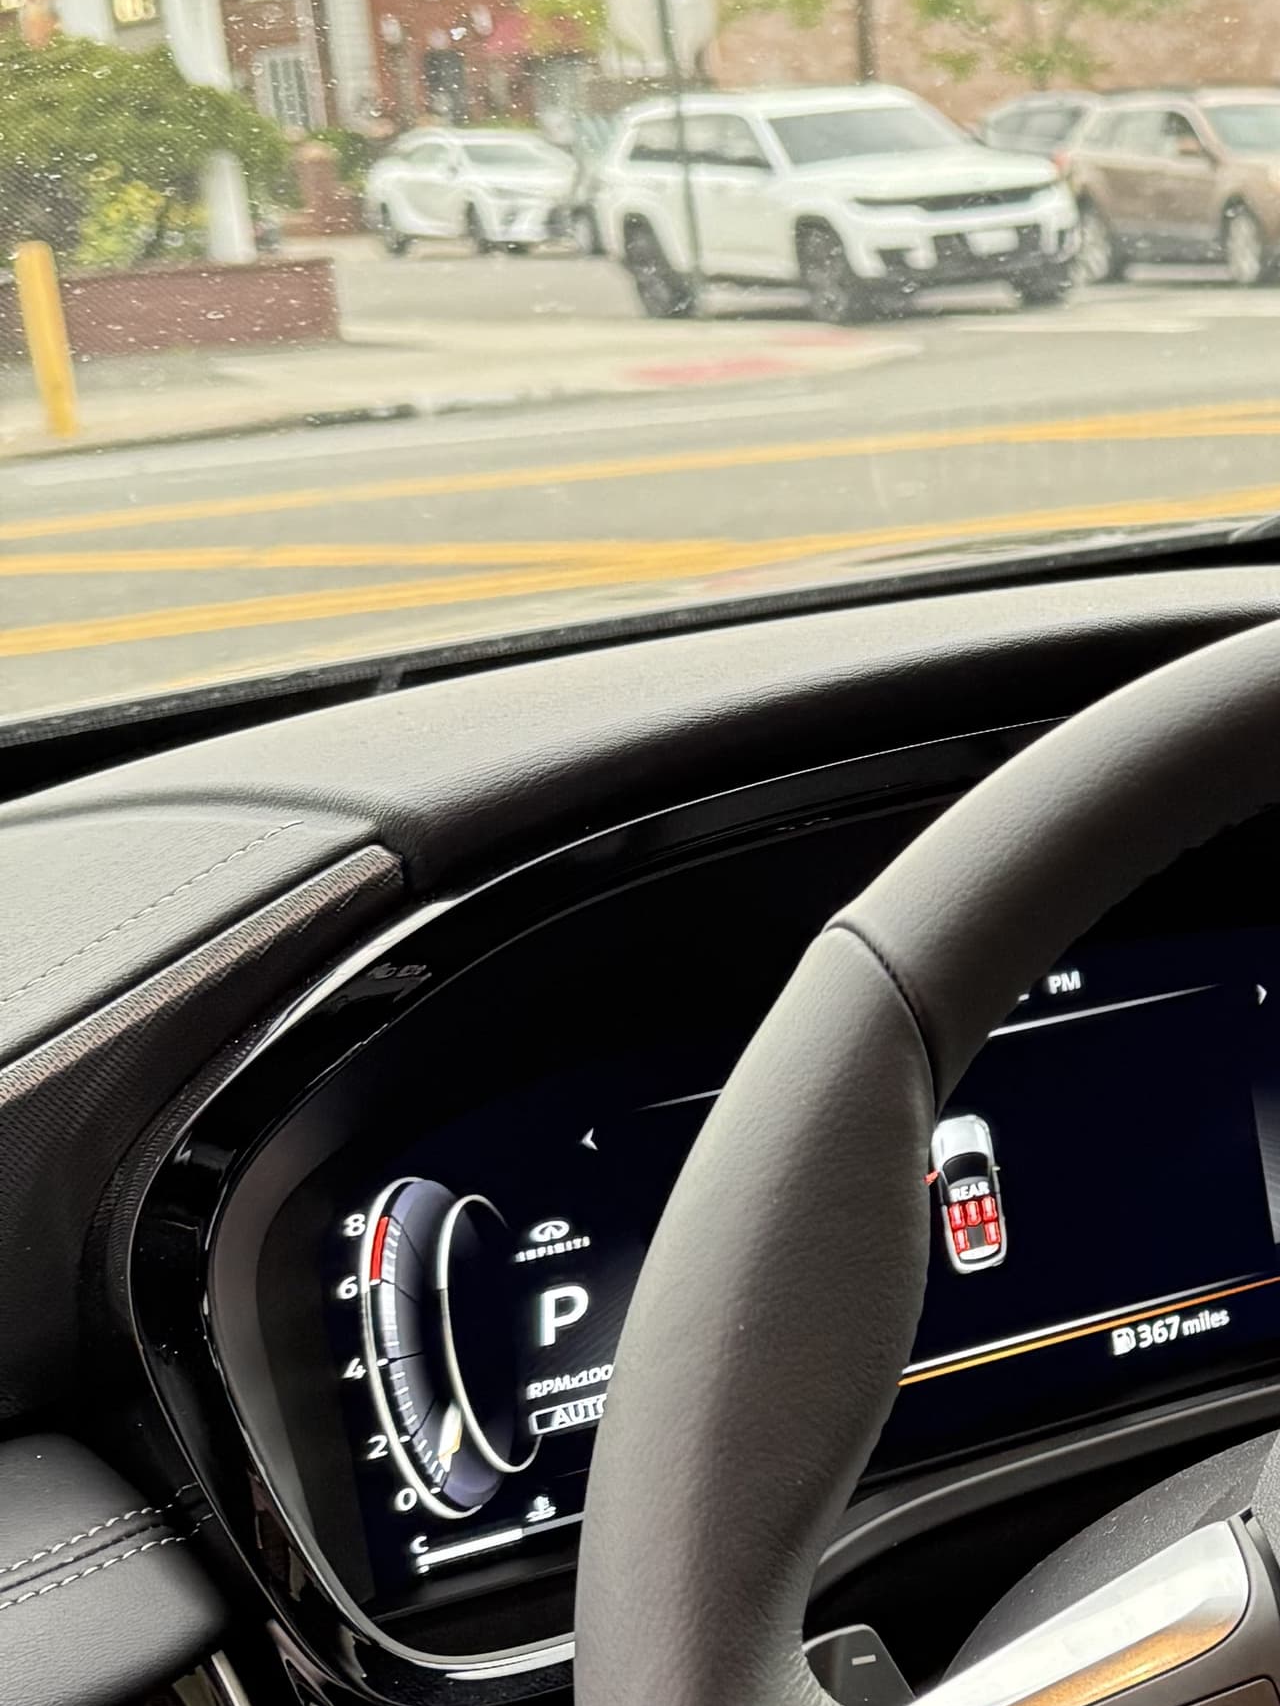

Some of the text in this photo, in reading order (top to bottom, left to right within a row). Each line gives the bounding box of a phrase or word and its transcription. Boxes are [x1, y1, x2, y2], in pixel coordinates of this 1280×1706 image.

[1049, 970, 1081, 994] PM
[950, 1181, 990, 1201] REAR
[343, 1213, 366, 1237] 8
[336, 1275, 359, 1299] 6
[540, 1285, 589, 1346] P
[1138, 1309, 1230, 1349] 367 miles
[342, 1358, 367, 1380] 4
[366, 1435, 388, 1460] 2
[394, 1487, 417, 1512] 0
[411, 1535, 429, 1553] C
